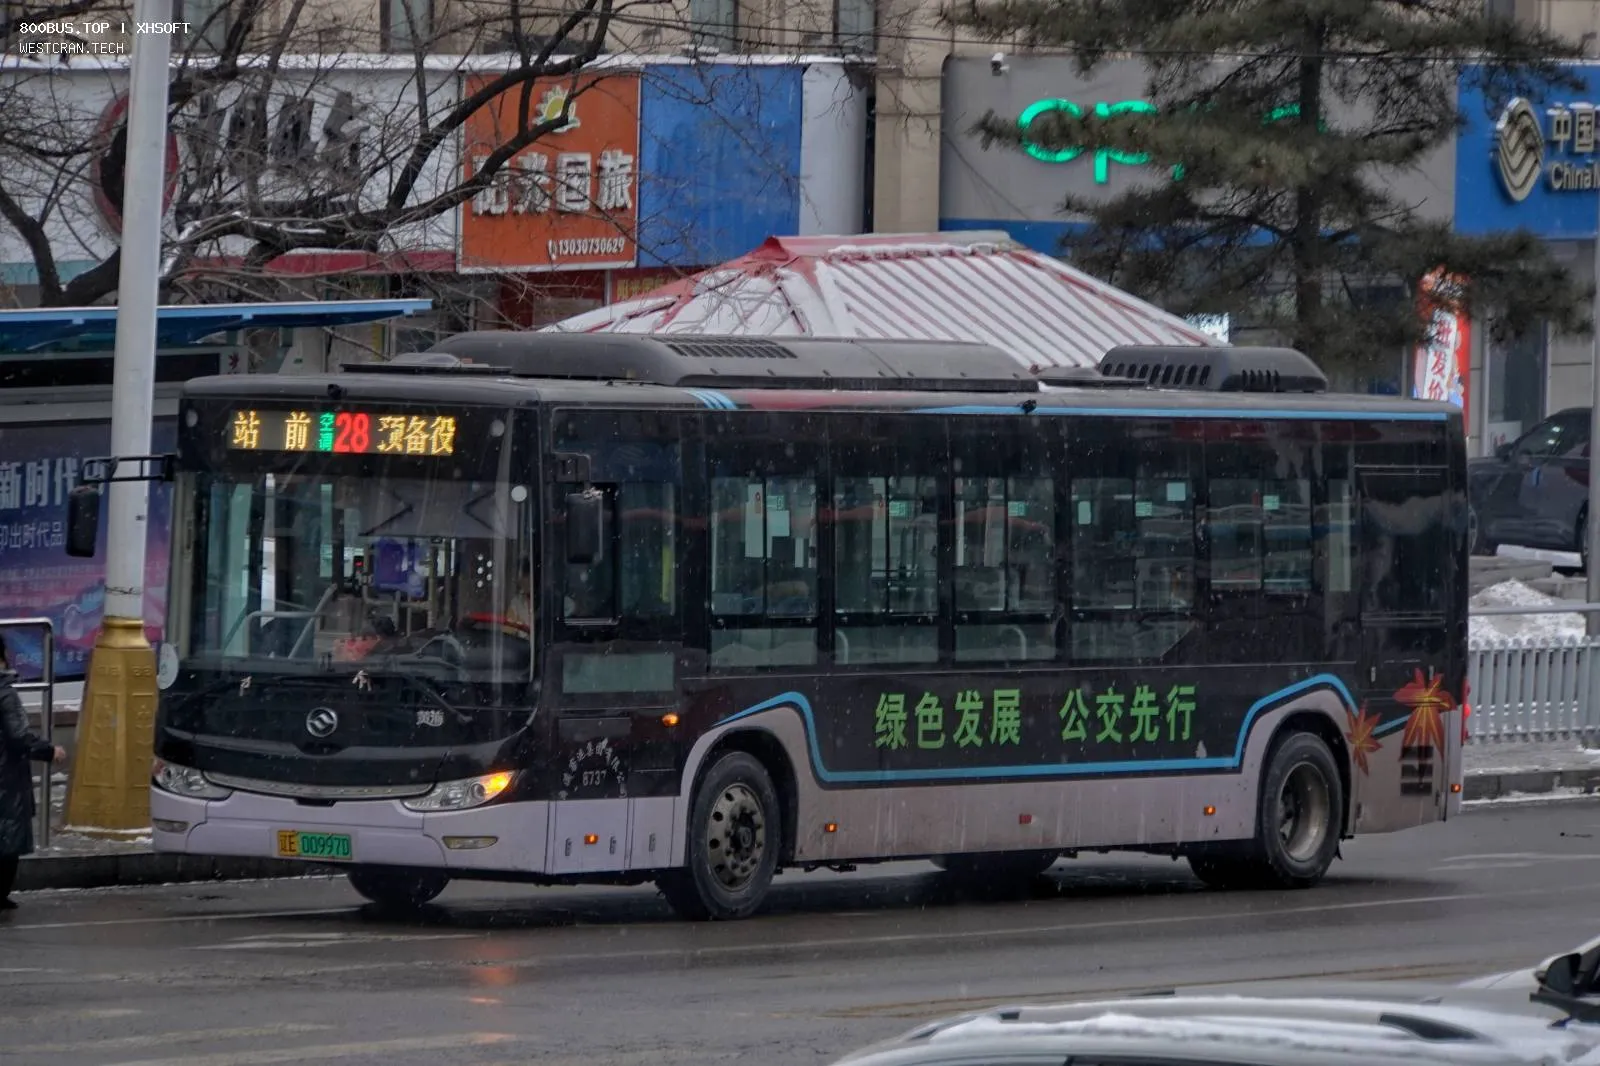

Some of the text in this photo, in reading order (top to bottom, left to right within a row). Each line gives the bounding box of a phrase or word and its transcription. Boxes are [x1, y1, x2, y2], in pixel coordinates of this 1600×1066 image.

[1550, 104, 1598, 154] 中国
[1551, 162, 1592, 190] China
[559, 237, 626, 257] 13030730629
[318, 412, 335, 452] 空调
[334, 411, 369, 453] 28
[874, 684, 1197, 750] 绿色发展 公交先行
